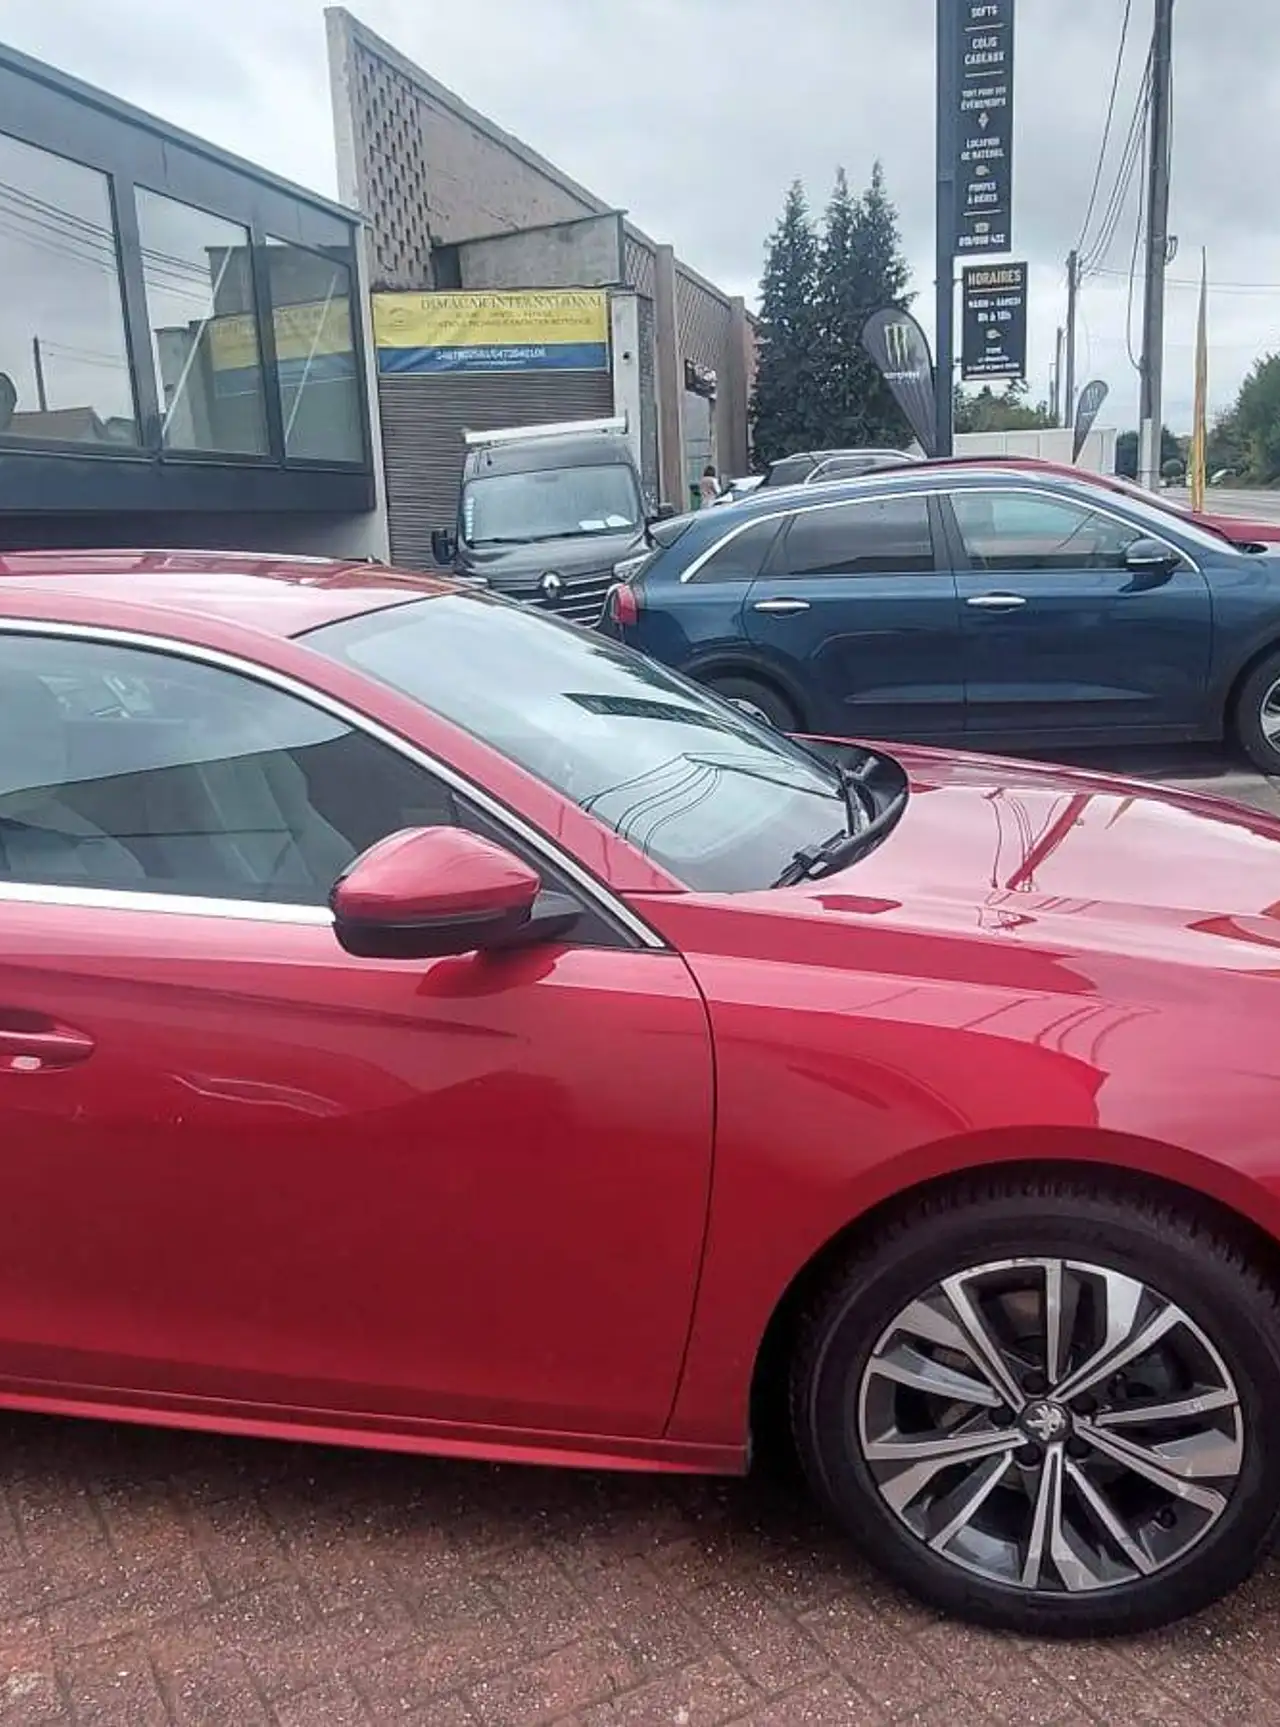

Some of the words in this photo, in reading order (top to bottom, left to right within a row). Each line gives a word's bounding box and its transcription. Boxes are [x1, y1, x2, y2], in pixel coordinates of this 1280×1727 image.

[972, 36, 998, 49] COLIS
[964, 51, 1005, 65] CADEAUX
[968, 269, 1022, 287] HORAIRES
